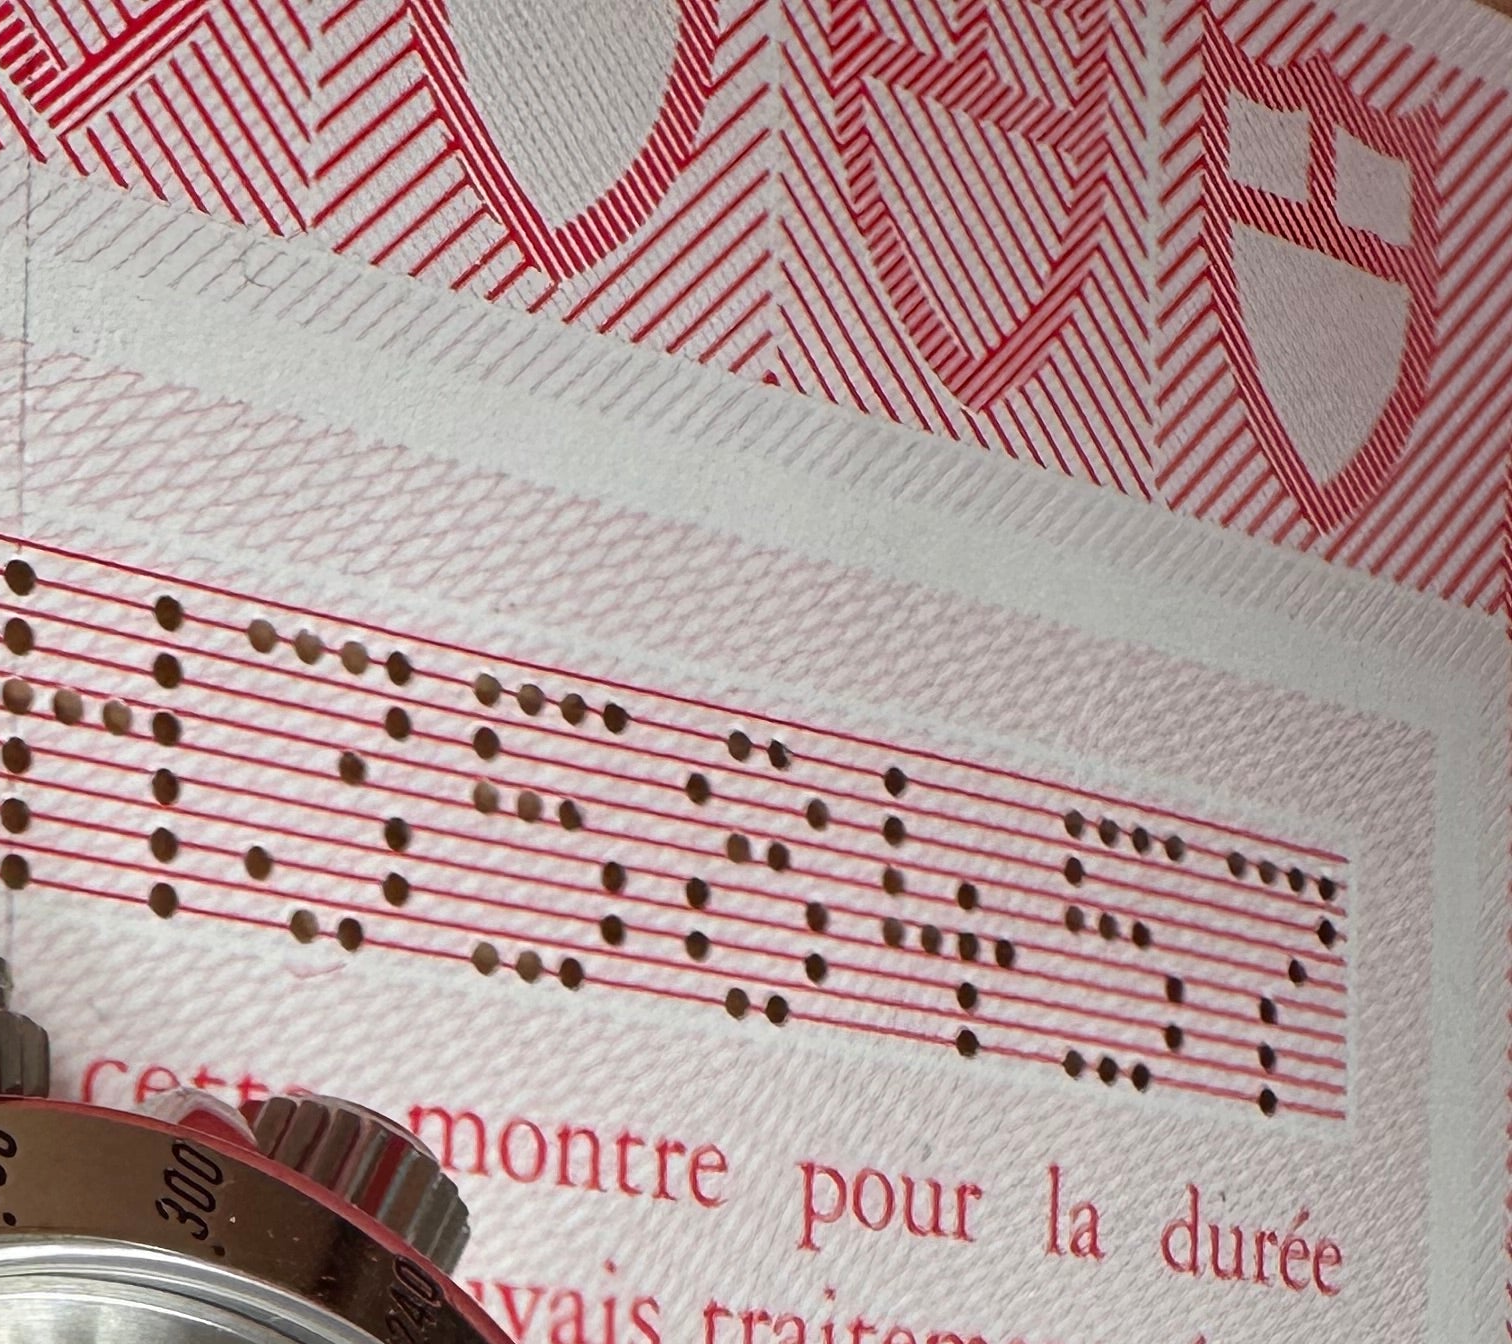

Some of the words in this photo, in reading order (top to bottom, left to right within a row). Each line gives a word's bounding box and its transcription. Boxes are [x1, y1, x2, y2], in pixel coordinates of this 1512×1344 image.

[155, 1139, 224, 1240] 300
[407, 1104, 728, 1208] montre
[799, 1158, 983, 1251] pour
[1048, 1167, 1105, 1260] la
[1161, 1186, 1342, 1297] durée
